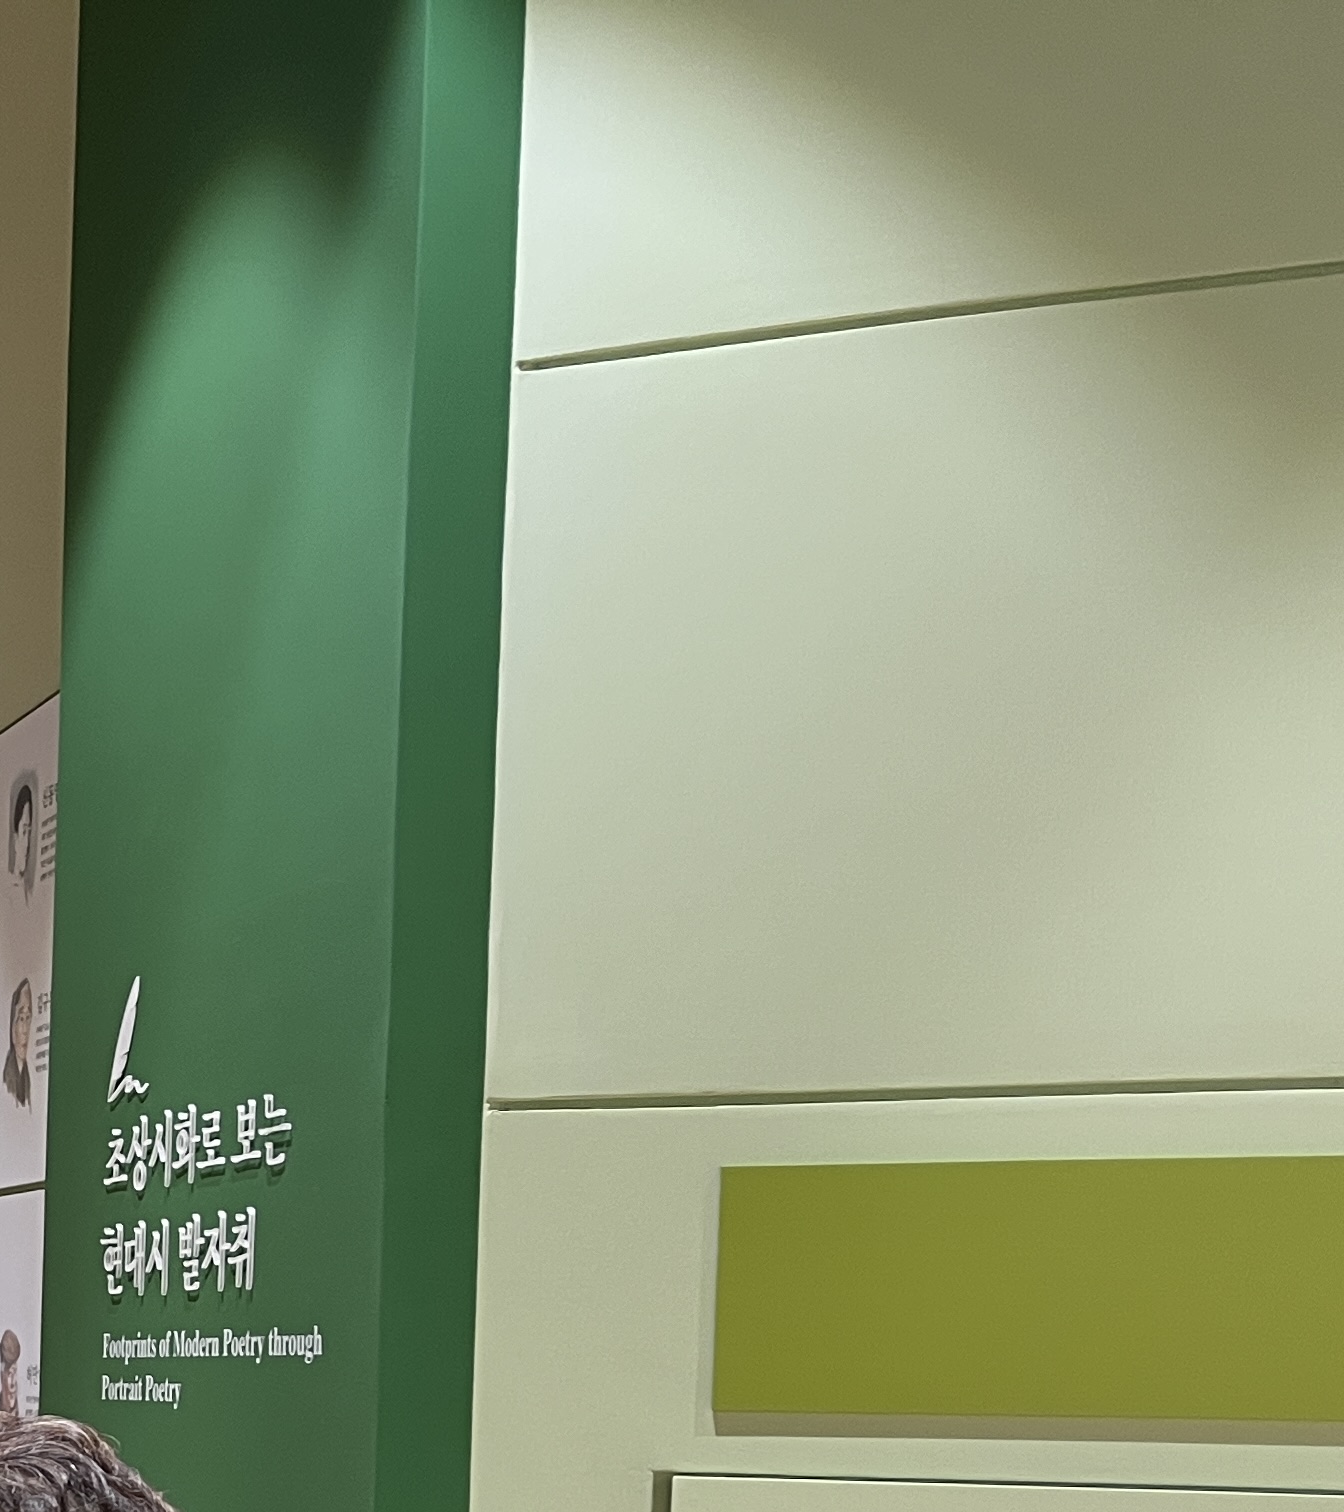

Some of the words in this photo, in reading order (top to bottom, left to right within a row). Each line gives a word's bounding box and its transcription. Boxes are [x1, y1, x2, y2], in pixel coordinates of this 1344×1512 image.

[103, 1103, 226, 1191] 초상시화로
[230, 1094, 292, 1166] 보는
[100, 1218, 170, 1296] 현대시
[178, 1206, 257, 1292] 발자취
[102, 1331, 157, 1366] Footprints
[158, 1330, 172, 1358] of
[172, 1329, 220, 1358] Modern
[222, 1328, 265, 1364] Poetry
[268, 1325, 323, 1364] through
[101, 1374, 143, 1401] Portrait
[144, 1374, 182, 1410] Poetry
